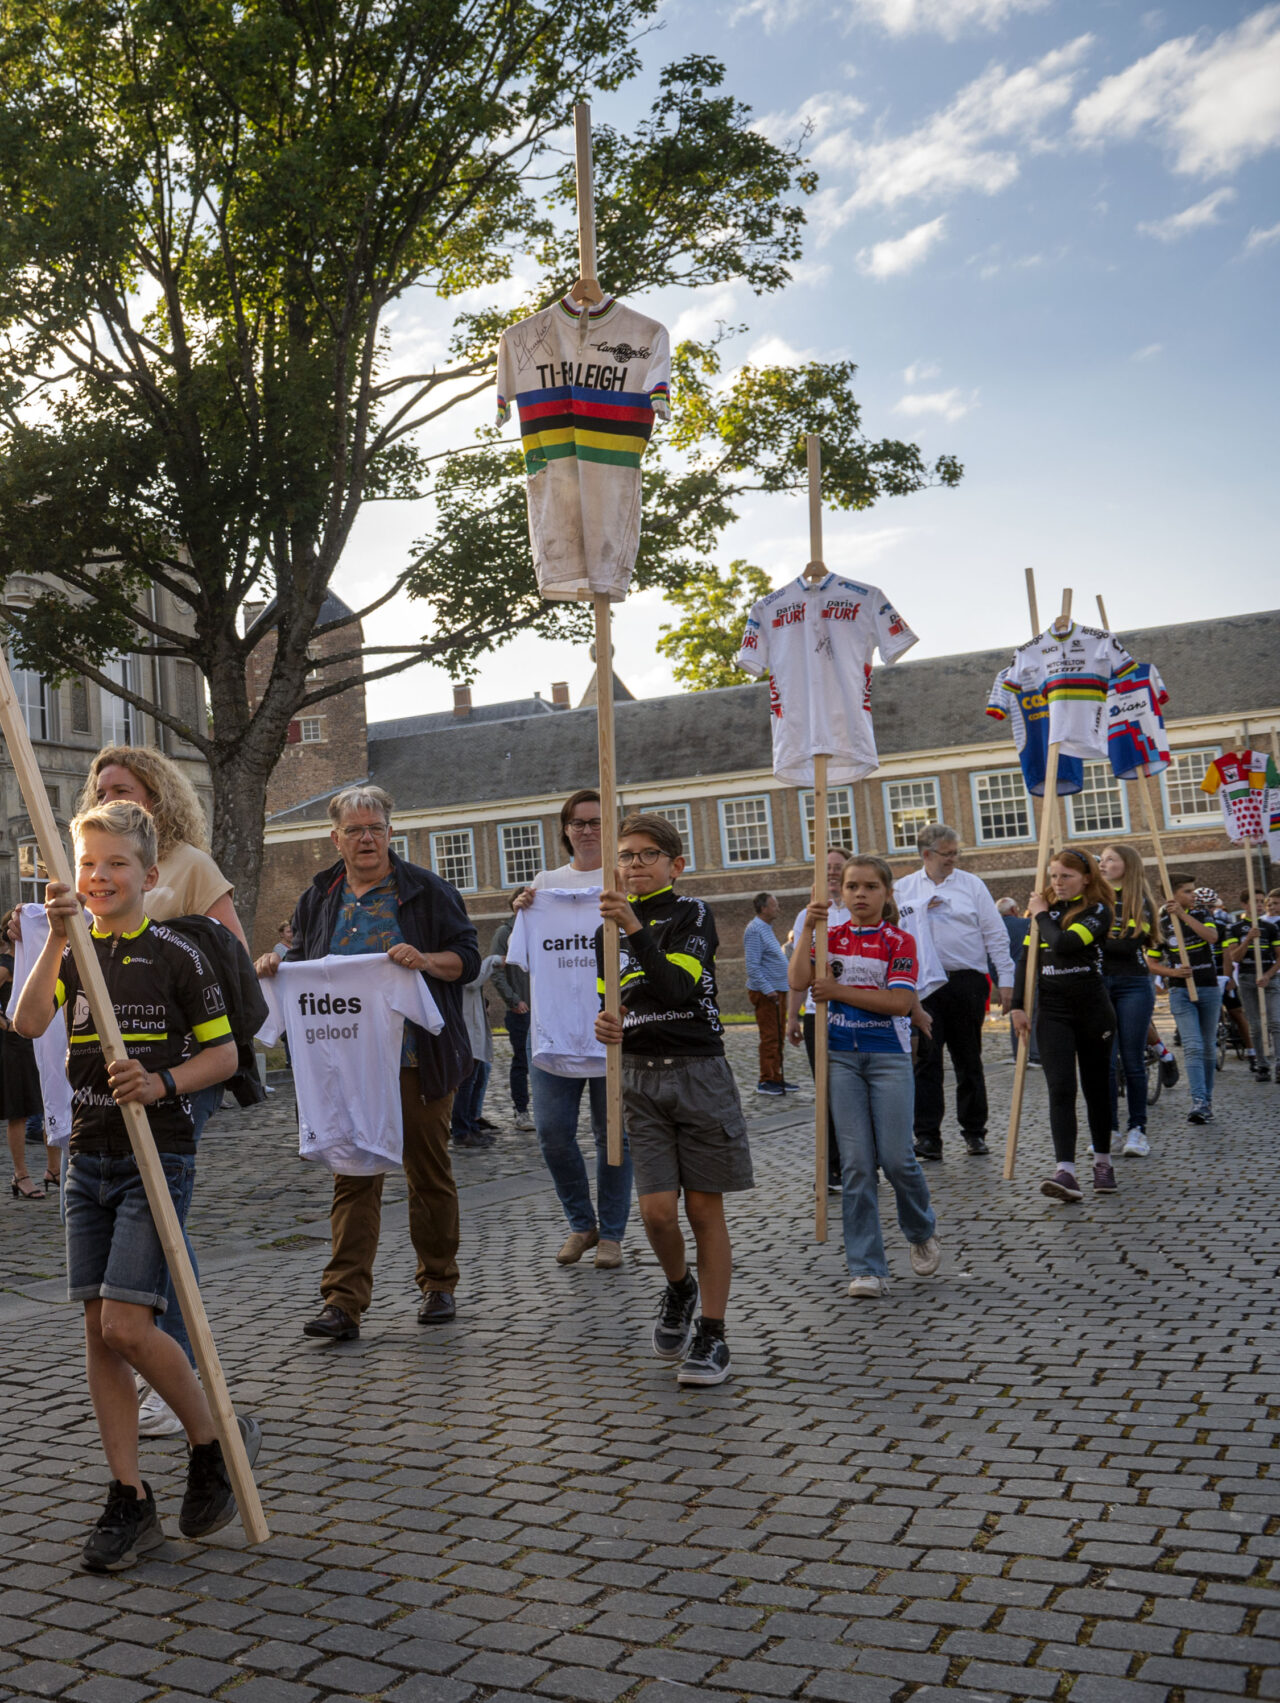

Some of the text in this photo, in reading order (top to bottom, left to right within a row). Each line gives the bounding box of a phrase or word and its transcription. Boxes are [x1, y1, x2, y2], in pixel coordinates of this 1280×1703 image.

[776, 602, 801, 618] paris
[826, 599, 854, 609] paris
[1081, 626, 1109, 639] letsgo
[558, 955, 597, 969] liefde
[298, 992, 362, 1016] fides
[132, 1018, 166, 1029] Fund
[637, 1010, 694, 1025] WielerShop
[305, 1022, 359, 1045] geloof
